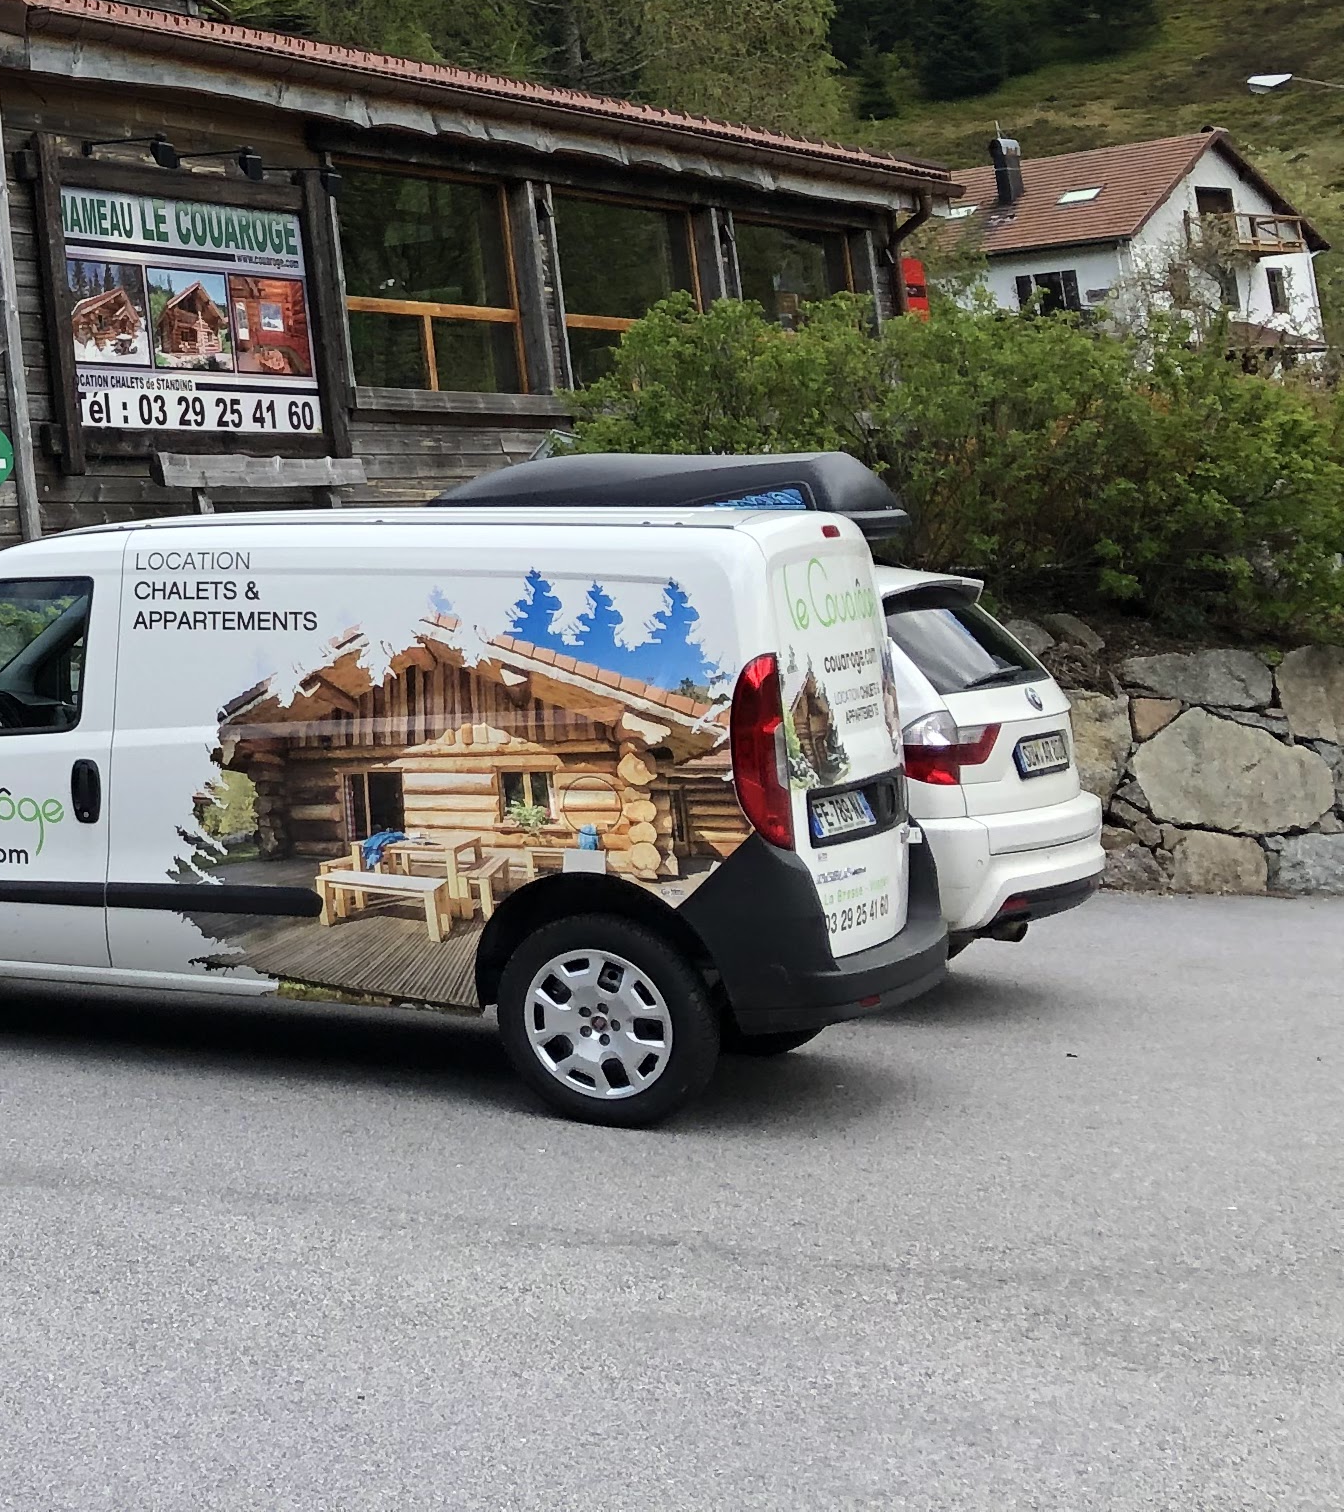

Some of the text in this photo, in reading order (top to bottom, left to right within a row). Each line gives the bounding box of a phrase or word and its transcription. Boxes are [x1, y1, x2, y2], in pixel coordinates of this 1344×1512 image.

[138, 196, 169, 242] LE
[174, 200, 299, 255] COUAROGE
[75, 373, 193, 392] OCATION CHALETS de STANDING
[138, 393, 168, 426] 03
[176, 395, 205, 427] 29
[215, 397, 243, 428] 25
[252, 399, 277, 429] 41
[288, 400, 314, 430] 60
[135, 552, 251, 571] LOCATION
[134, 581, 261, 600] CHALETS &
[132, 611, 318, 631] APPARTEMENTS
[841, 908, 854, 931] 29
[856, 902, 868, 926] 25
[869, 899, 878, 920] 41
[880, 894, 889, 916] 60
